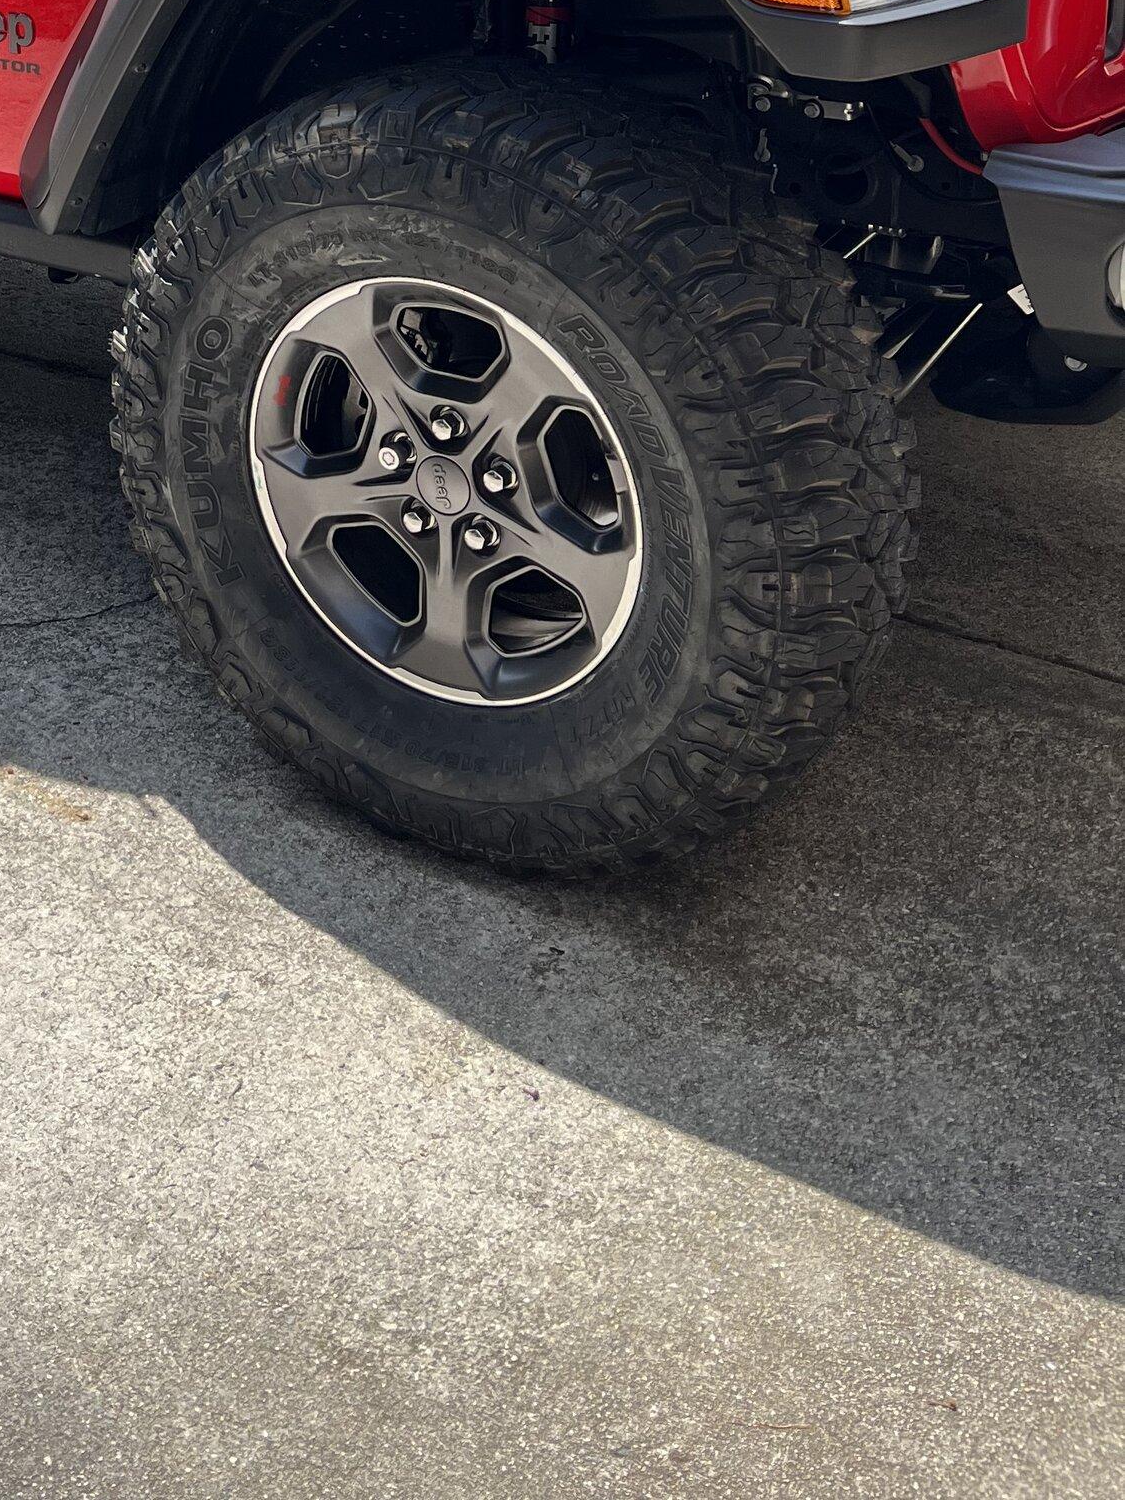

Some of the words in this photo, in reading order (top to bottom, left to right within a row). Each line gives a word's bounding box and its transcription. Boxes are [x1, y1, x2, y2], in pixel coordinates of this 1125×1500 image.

[179, 316, 246, 587] KUMHO
[432, 463, 452, 510] Jeep
[556, 314, 673, 459] ROAD
[633, 462, 696, 705] VENTURE
